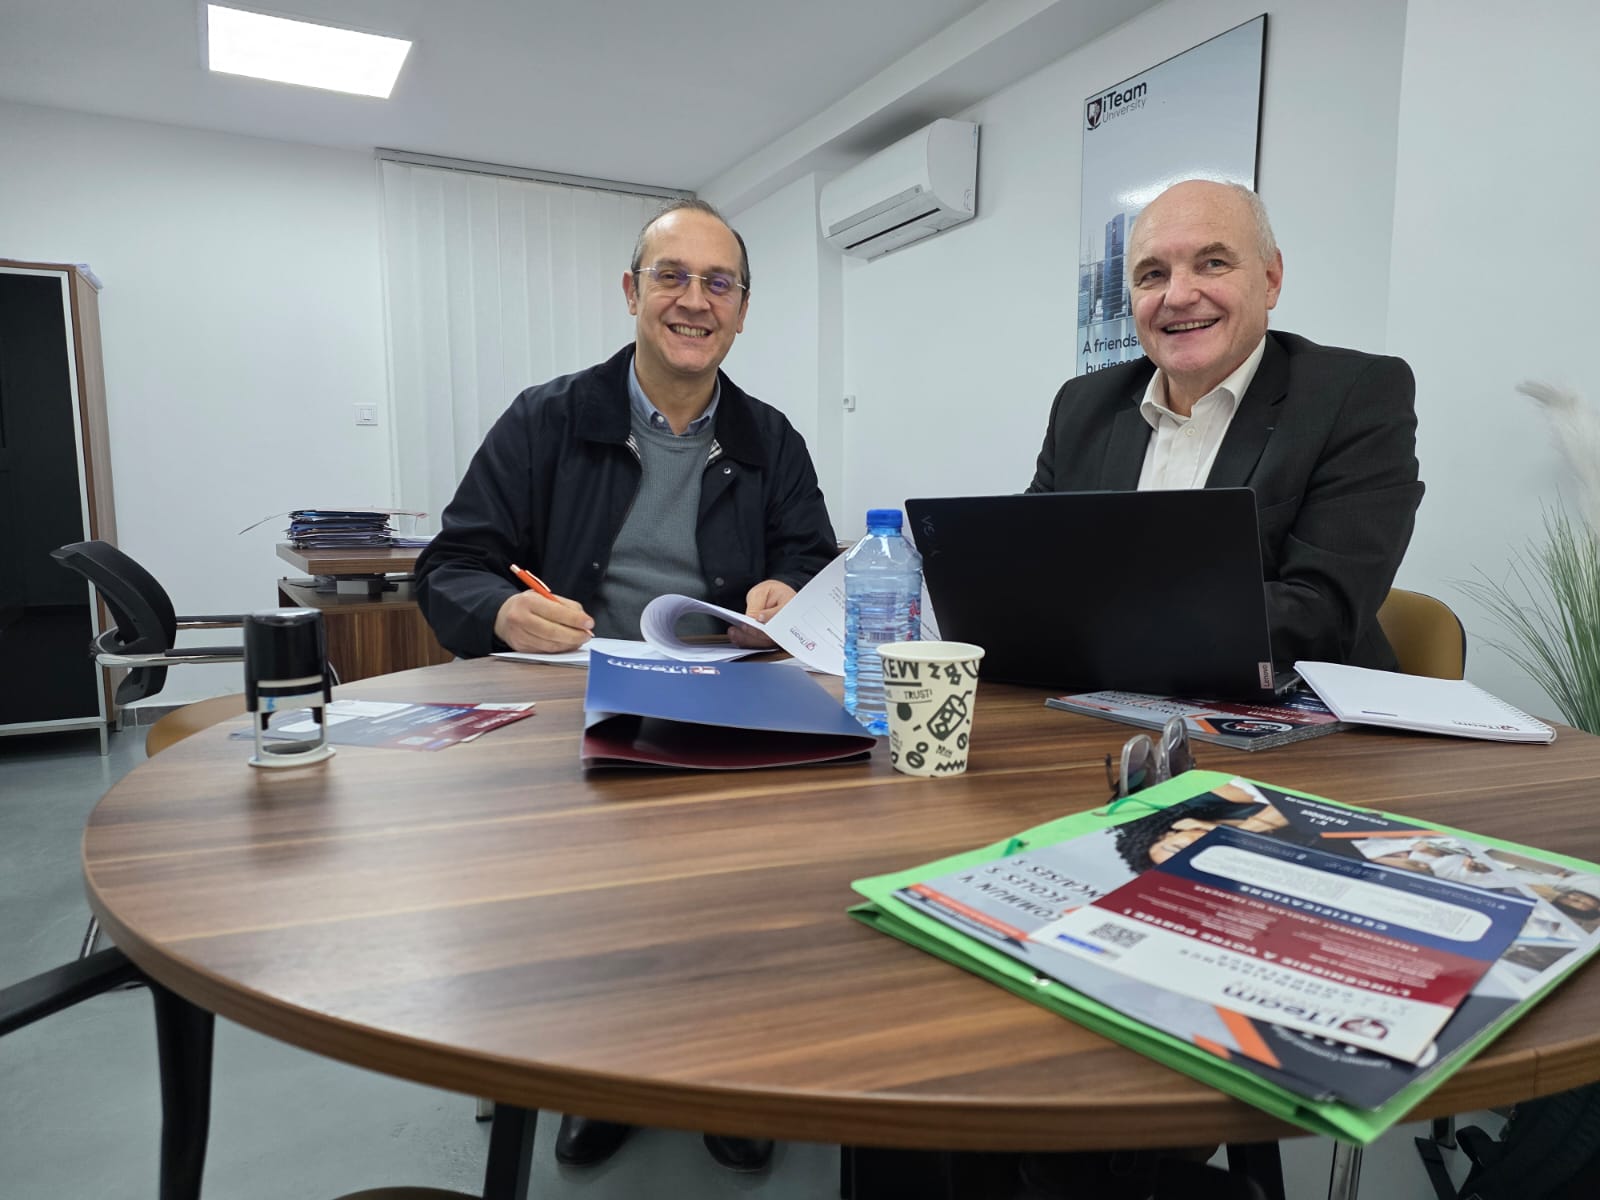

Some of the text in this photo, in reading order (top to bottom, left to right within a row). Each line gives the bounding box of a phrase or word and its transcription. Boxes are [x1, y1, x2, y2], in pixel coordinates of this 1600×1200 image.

[1103, 82, 1147, 113] iTeam
[1102, 97, 1147, 123] University
[1082, 340, 1092, 355] A
[789, 627, 808, 646] iTeam
[1262, 664, 1271, 687] Lenovo
[1239, 885, 1389, 931] CERTIFICATIONS
[1200, 933, 1258, 953] VOTRE
[1221, 984, 1339, 1027] iTeam
